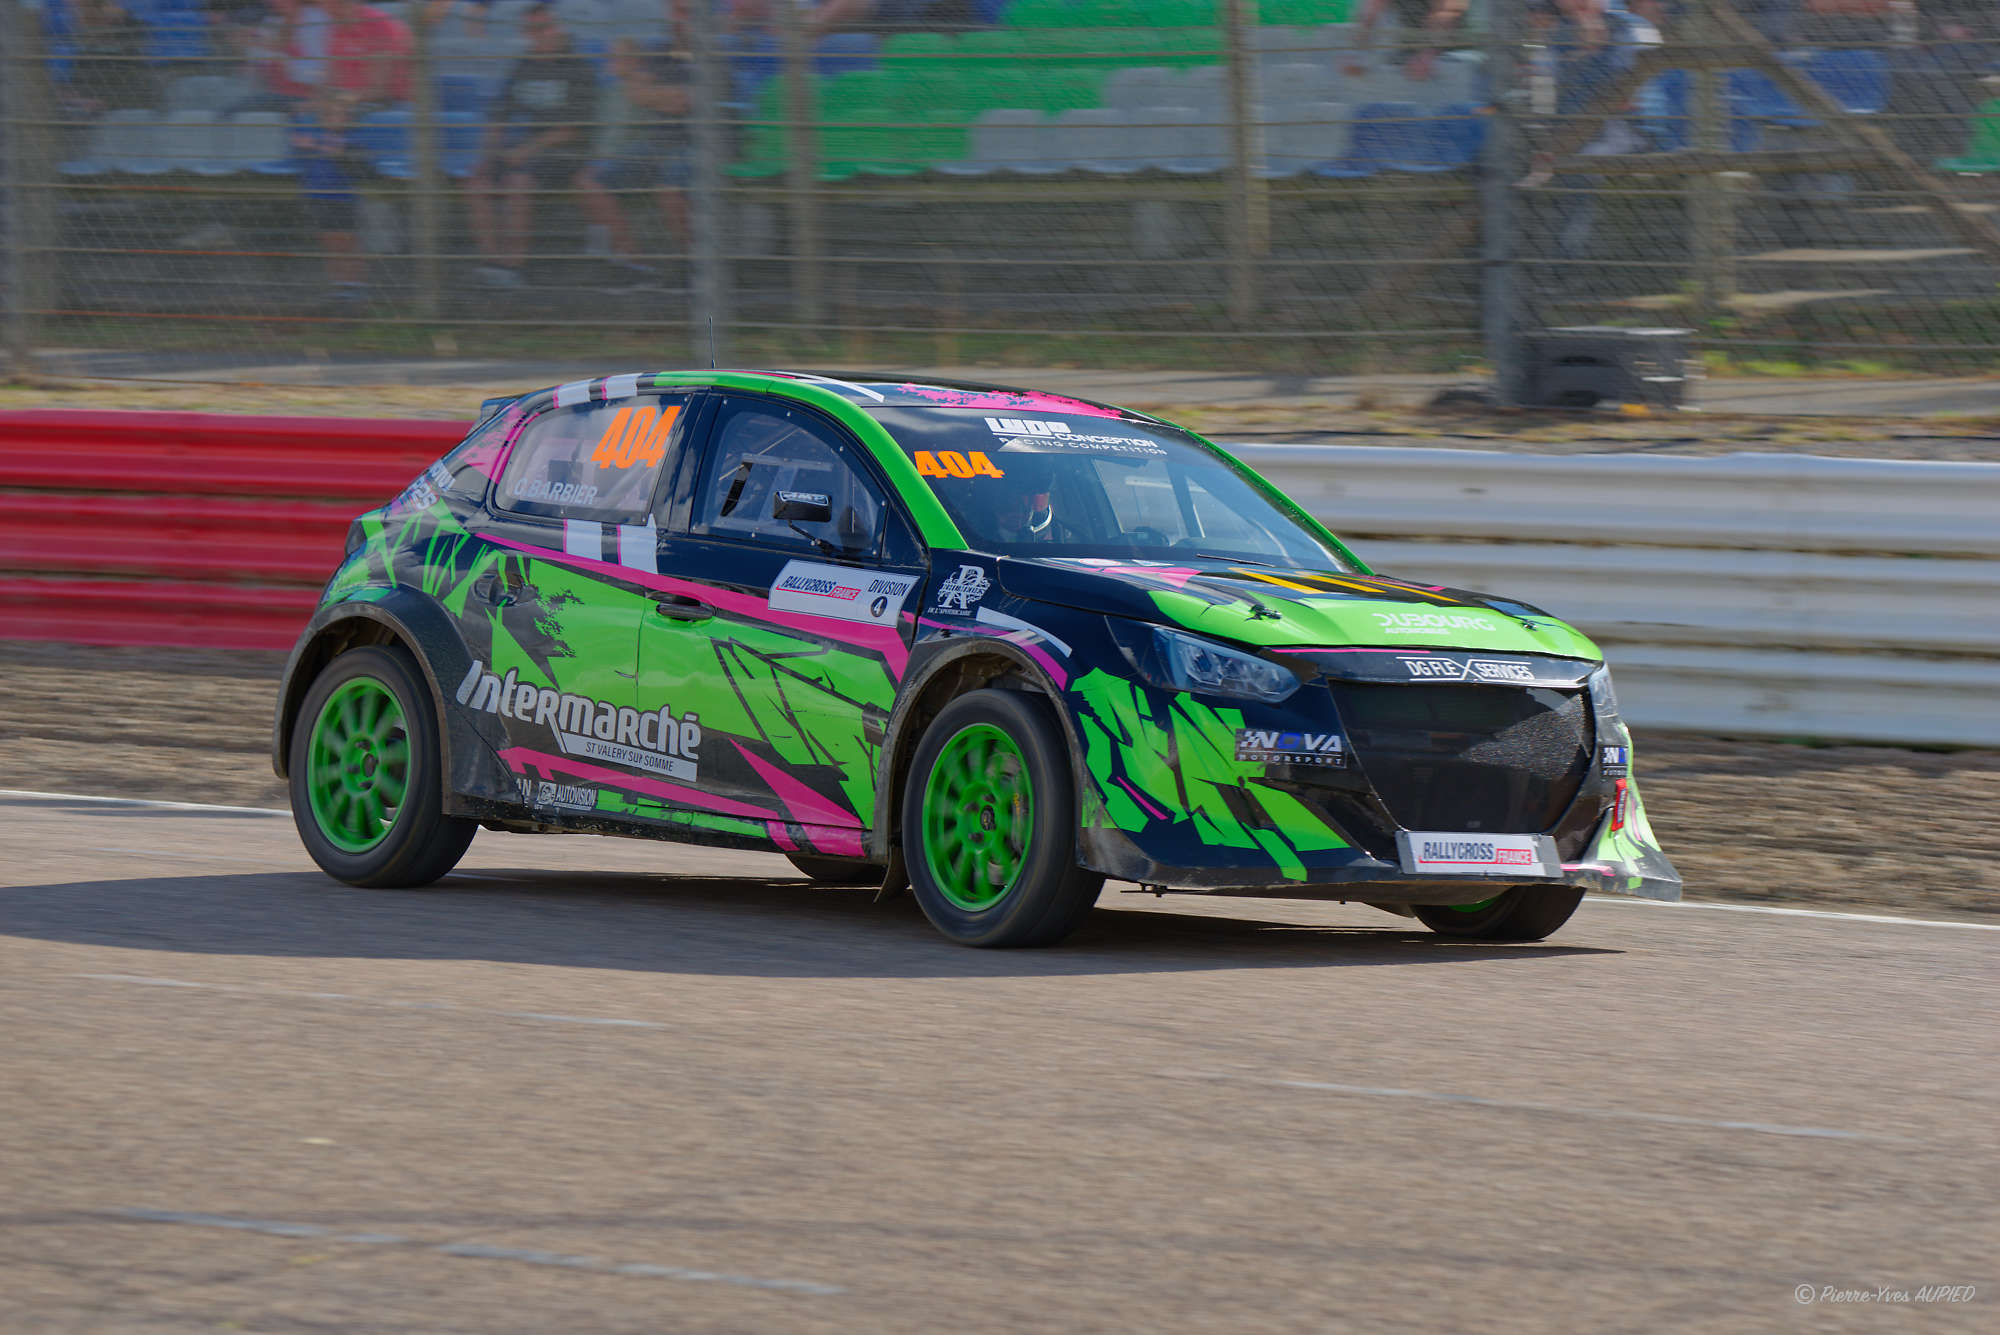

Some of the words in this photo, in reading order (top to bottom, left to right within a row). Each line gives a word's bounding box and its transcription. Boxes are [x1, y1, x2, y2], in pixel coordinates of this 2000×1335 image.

[591, 405, 681, 469] 404
[1054, 433, 1158, 448] CONCEPTION
[1069, 442, 1167, 455] COMPETITION
[914, 451, 1005, 478] 404
[781, 576, 836, 594] RALLYCROSS
[868, 579, 910, 596] DIVISION
[873, 598, 884, 614] 4
[1371, 613, 1496, 631] DUBOURG
[1474, 663, 1535, 680] SERVICES
[456, 660, 701, 760] Intermarché
[586, 742, 597, 753] ST
[597, 744, 628, 759] VALERY
[644, 755, 674, 772] SOMME
[1239, 755, 1341, 764] MOTORSPORT
[556, 784, 597, 806] AUTOVISION
[1424, 842, 1493, 860] RALLYCROSS
